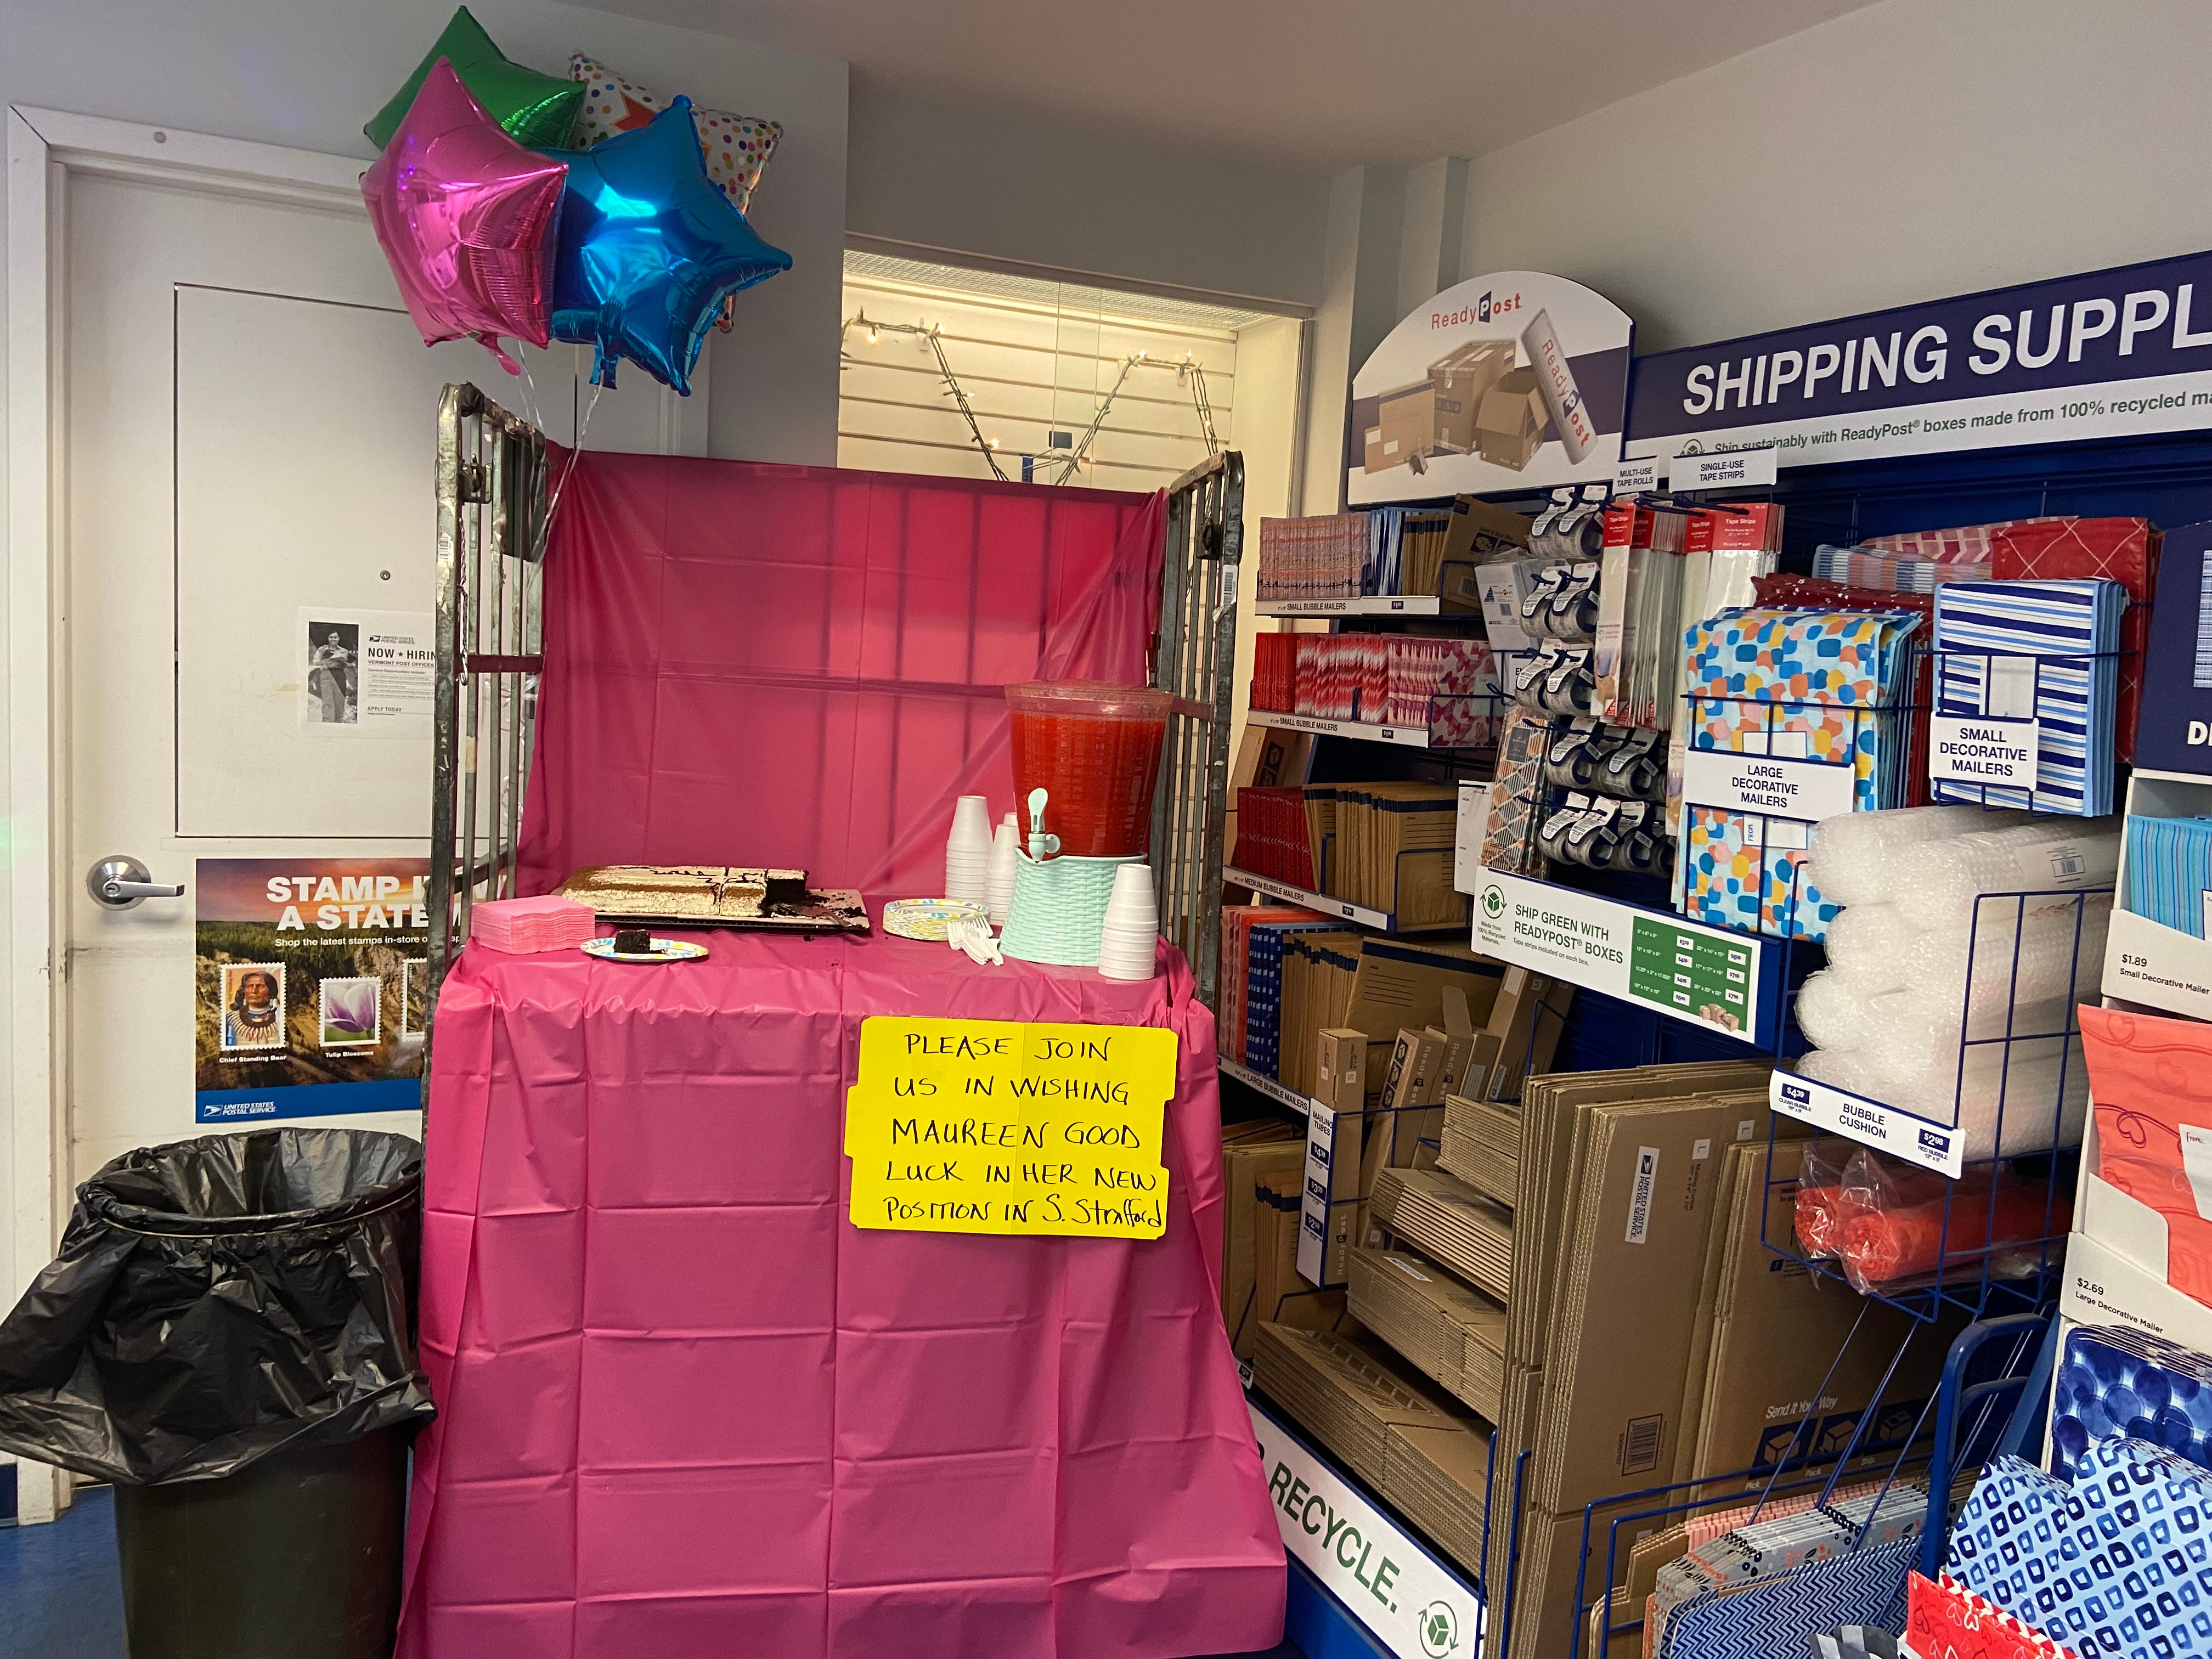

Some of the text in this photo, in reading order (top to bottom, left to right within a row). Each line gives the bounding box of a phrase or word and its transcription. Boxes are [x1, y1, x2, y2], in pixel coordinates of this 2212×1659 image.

[1431, 291, 1522, 330] ReadyPost
[1683, 283, 2212, 415] SHIPPING SUPPL
[1541, 338, 1590, 447] ReadyPost
[1742, 434, 1807, 448] sustainably
[1812, 430, 1837, 444] with
[1924, 419, 1966, 433] boxes
[1971, 411, 2012, 427] made
[2017, 408, 2054, 422] from
[2060, 400, 2104, 418] 100%
[2111, 391, 2186, 414] recycled
[1620, 467, 1652, 477] MULTI-USE
[1700, 471, 1745, 482] TAPE STRIPS
[1701, 460, 1744, 471] SINGLE-USE
[1633, 477, 1653, 486] ROLLS
[368, 648, 394, 658] NOW
[1280, 718, 1295, 726] SMALL
[1296, 720, 1315, 729] BUBBLE
[1316, 723, 1338, 731] MAILERS
[1960, 727, 2007, 743] SMALL
[1940, 741, 2027, 761] DECORATIVE
[1747, 765, 1782, 778] LARGE
[1952, 758, 2013, 777] MAILERS
[1732, 777, 1798, 795] DECORATIVE
[1741, 792, 1787, 808] MAILERS
[266, 876, 431, 902] STAMP I
[1244, 877, 1262, 889] MEDIUM
[1263, 883, 1282, 895] BUBBLE
[1283, 889, 1304, 901] MAILERS
[276, 904, 429, 930] A STATE
[1515, 904, 1609, 941] SHIP GREEN WITH
[275, 939, 300, 947] Shop
[303, 938, 318, 946] the
[320, 937, 346, 945] latest
[348, 937, 382, 946] stamps
[1488, 930, 1505, 940] Recycled
[1514, 937, 1523, 946] Tape
[1525, 941, 1537, 950] strips
[1538, 945, 1558, 956] included
[1566, 953, 1577, 962] each
[1579, 957, 1589, 966] box.
[1585, 942, 1623, 964] BOXES
[2121, 954, 2147, 967] $1.89
[2120, 968, 2210, 994] Small Decorative Mailer
[904, 1034, 1111, 1062] PLEASE JOIN
[1409, 1045, 1431, 1105] ReadyPost
[1438, 1043, 1459, 1102] ReadyPost
[895, 1076, 1128, 1105] US IN WISHING
[1248, 1074, 1263, 1088] LARGE
[1264, 1082, 1283, 1098] BUBBLE
[1285, 1093, 1307, 1110] MAILERS
[1313, 1110, 1333, 1128] MAILING
[1794, 1103, 1812, 1111] BUBBLE
[1843, 1103, 1885, 1125] BUBBLE
[892, 1118, 1140, 1148] MAUREEN GOOD
[1314, 1120, 1330, 1136] TUBES
[1839, 1115, 1886, 1139] CUSHION
[1929, 1149, 1948, 1160] BUBBLE
[886, 1161, 1156, 1191] LUCK IN HER NEW
[1642, 1177, 1650, 1206] UNITED
[883, 1193, 1162, 1228] POSITION IN S. Strafford
[1631, 1176, 1645, 1238] POSTAL SERVICE
[1337, 1213, 1347, 1276] ReadyPost
[2077, 1277, 2104, 1295] $2.69
[2075, 1291, 2163, 1334] Large Decorative Mailer
[1766, 1396, 1837, 1419] Send It Way
[1268, 1460, 1400, 1614] RECYCLE.
